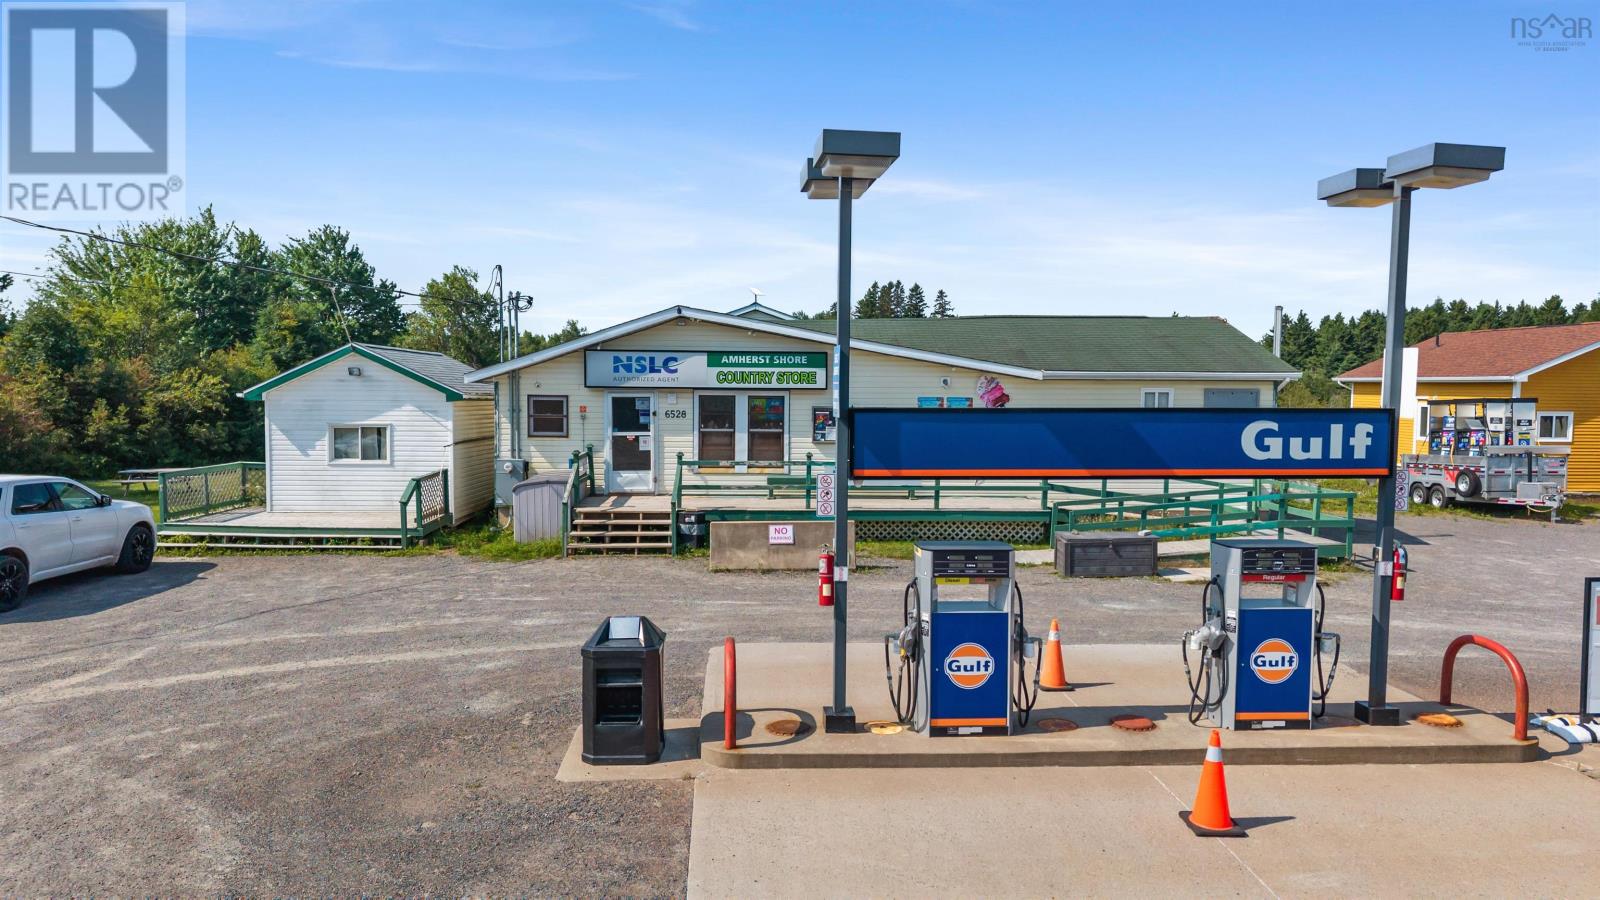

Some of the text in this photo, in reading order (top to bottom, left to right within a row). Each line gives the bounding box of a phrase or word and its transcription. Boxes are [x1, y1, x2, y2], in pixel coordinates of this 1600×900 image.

[613, 355, 678, 374] NSLC
[721, 355, 808, 364] AMHERST SHORE
[716, 370, 817, 385] COUNTRY STORE
[665, 410, 687, 419] 6528
[1240, 420, 1374, 461] Gulf
[774, 527, 788, 535] NO
[947, 659, 991, 673] Gulf
[1253, 654, 1295, 668] Gulf
